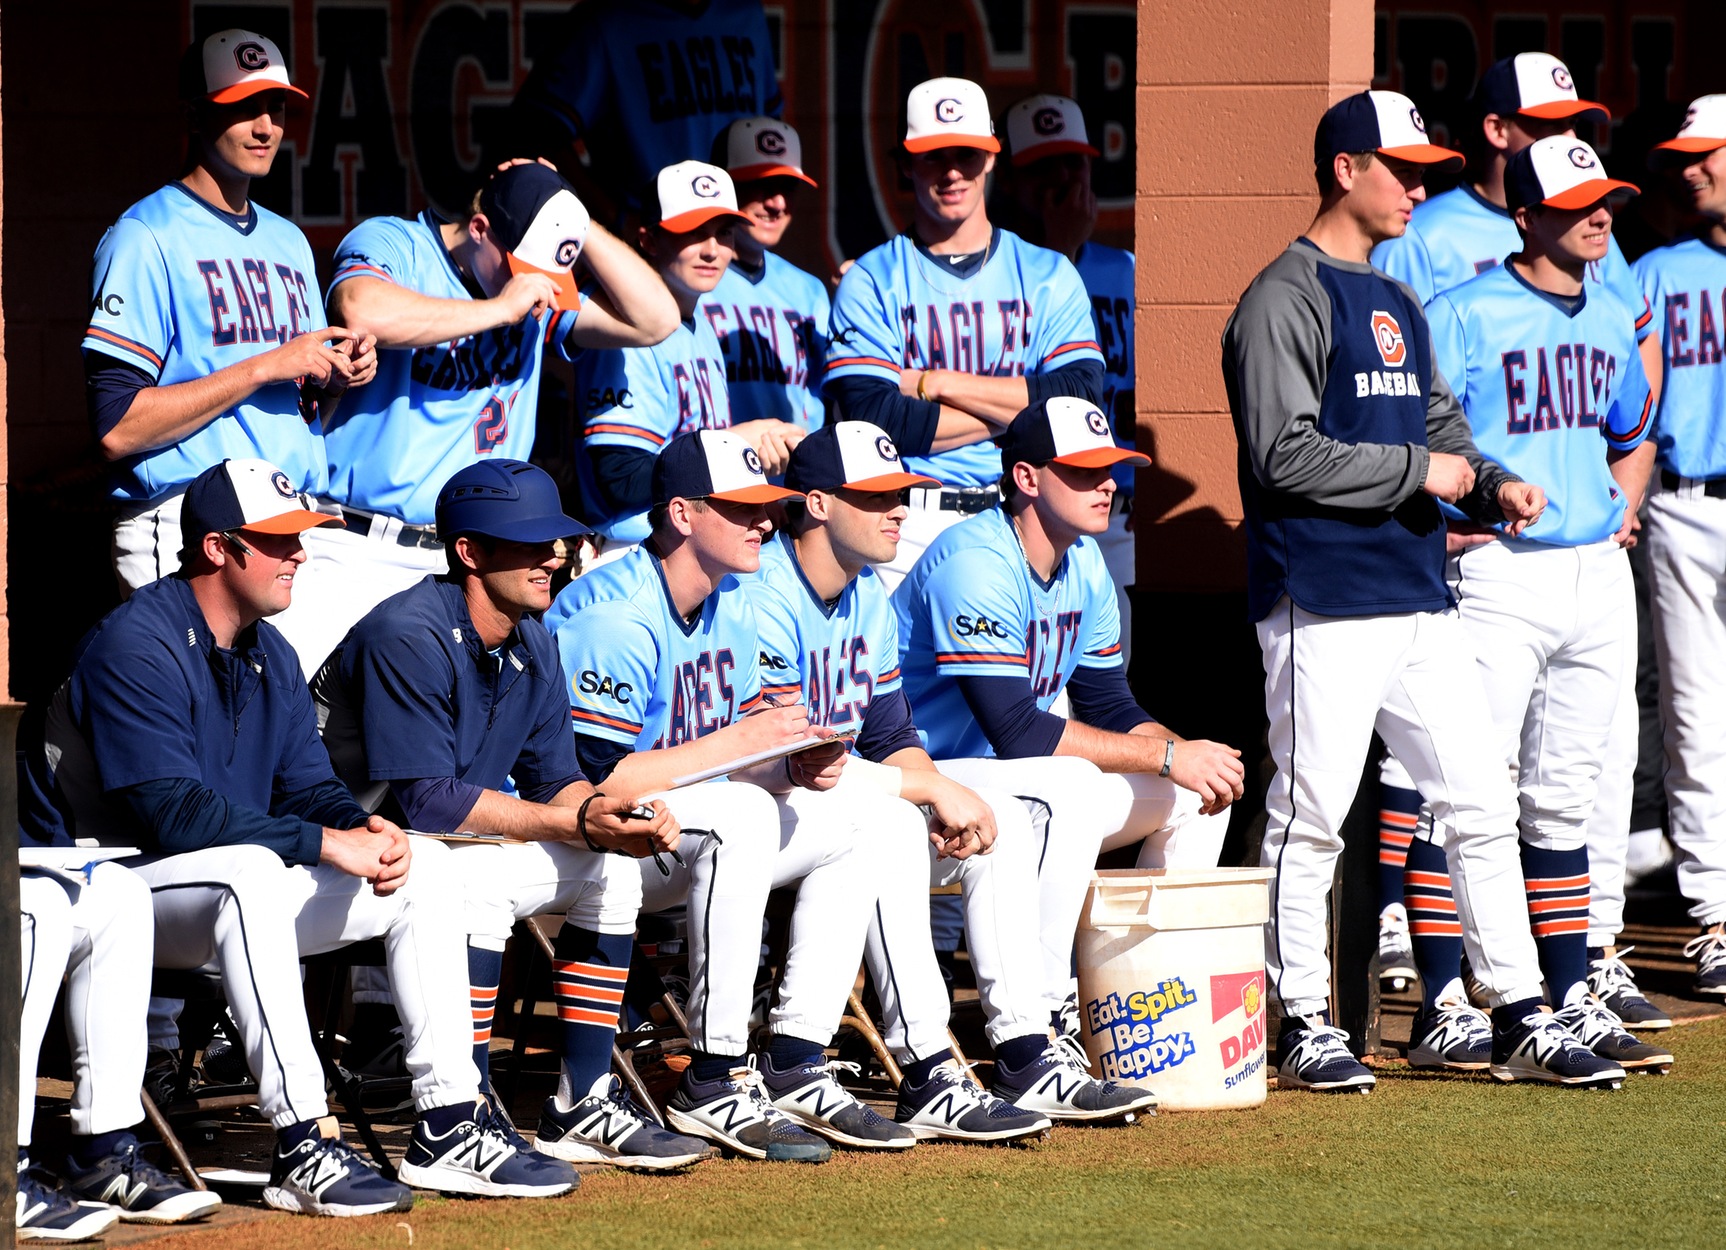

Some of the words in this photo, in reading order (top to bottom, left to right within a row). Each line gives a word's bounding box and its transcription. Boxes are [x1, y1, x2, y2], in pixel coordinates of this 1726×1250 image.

[1665, 286, 1726, 368] EA
[586, 386, 634, 409] SAC
[955, 614, 1009, 639] SAC
[579, 669, 634, 705] SAC
[1128, 979, 1196, 1022] Spit.
[1113, 1022, 1152, 1052] Be
[1219, 1009, 1266, 1070] DAV
[1101, 1031, 1193, 1083] Happy.
